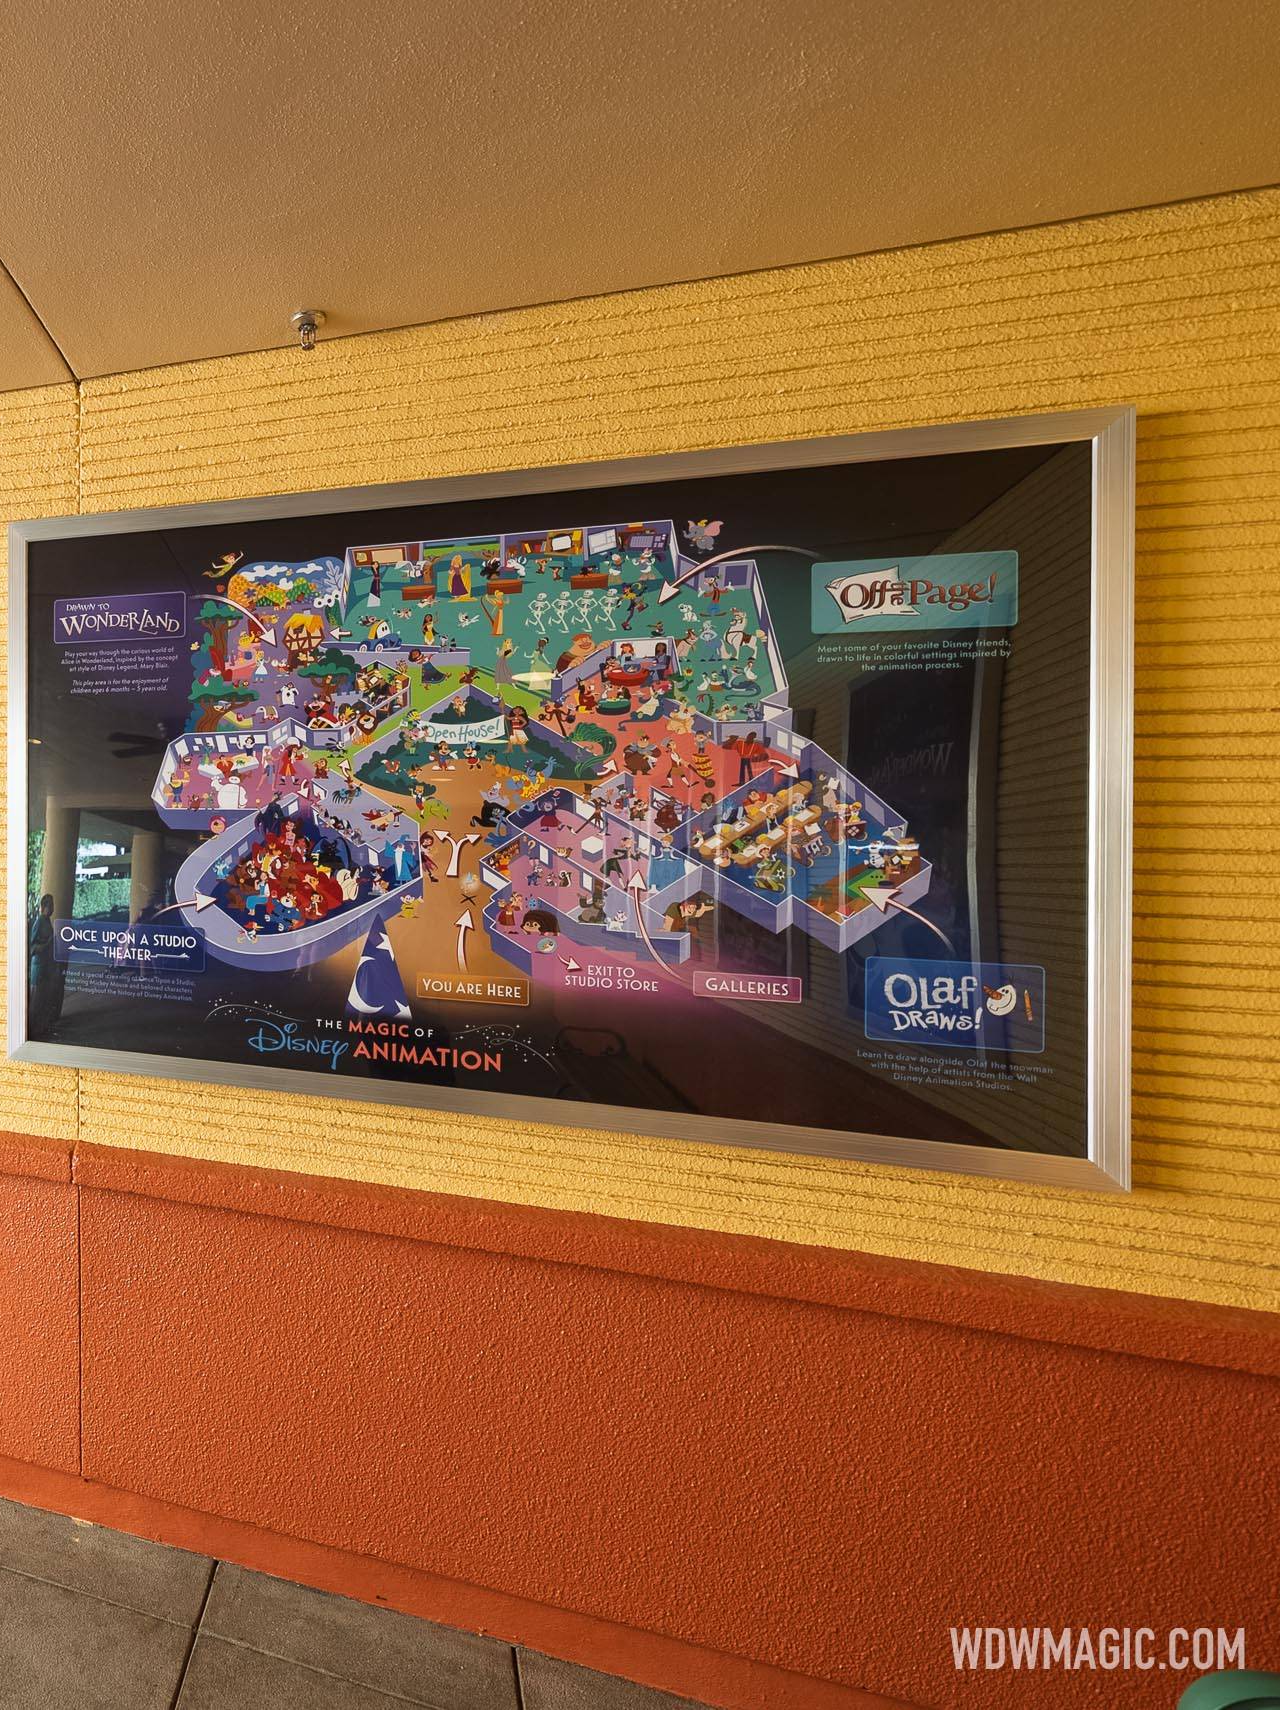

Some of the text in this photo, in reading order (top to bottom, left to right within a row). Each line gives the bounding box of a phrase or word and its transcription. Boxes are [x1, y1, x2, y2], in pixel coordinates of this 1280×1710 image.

[840, 580, 892, 610] Off
[908, 572, 998, 612] Page!
[66, 602, 110, 612] DRAWN TO
[870, 643, 880, 651] of
[882, 644, 902, 652] your
[904, 642, 940, 650] favorite
[942, 640, 974, 650] Disney
[976, 638, 1011, 647] friends,
[884, 652, 919, 660] colorful
[921, 651, 957, 660] settings
[960, 649, 997, 660] inspired
[1000, 648, 1012, 658] by
[861, 662, 962, 672] the animation process.
[428, 726, 456, 741] Open
[60, 926, 196, 948] ONCE UPON A STUDIO
[102, 946, 151, 960] THEATER
[588, 964, 636, 978] EXIT TO
[422, 978, 521, 998] YOU ARE HERE
[565, 975, 659, 992] STUDIO STORE
[705, 977, 789, 996] GALLERIES
[316, 1018, 434, 1039] THE MAGIC OF
[352, 1040, 502, 1072] ANIMATION
[857, 1049, 1054, 1074] Learn to draw alongside Olaf the snowman
[871, 1061, 1037, 1083] with the help of artists from the Walt
[893, 1072, 923, 1084] Disney
[926, 1076, 973, 1087] Animation
